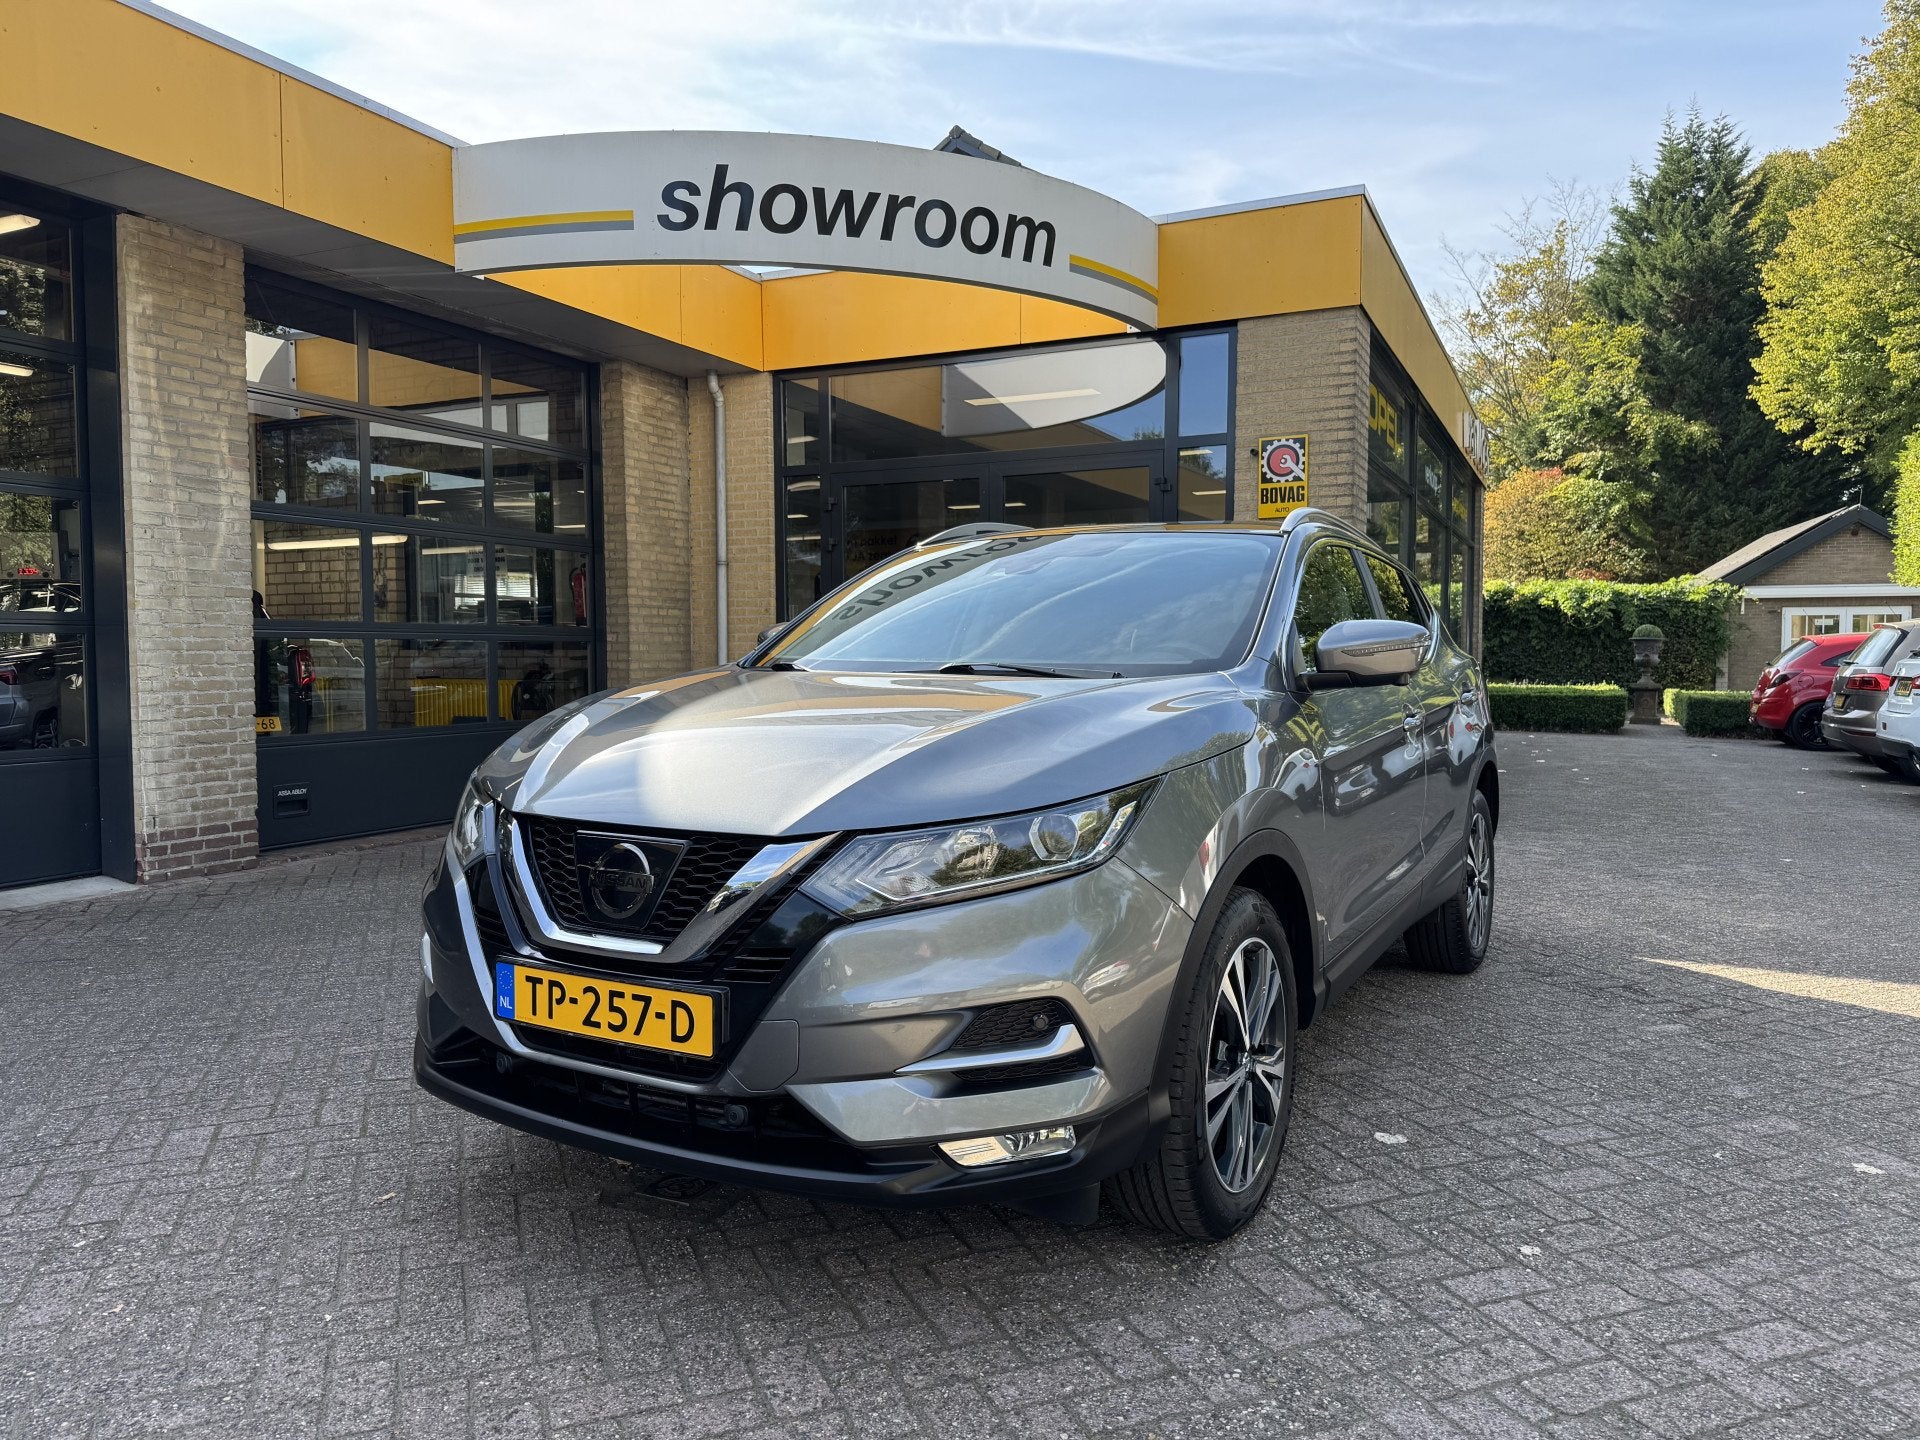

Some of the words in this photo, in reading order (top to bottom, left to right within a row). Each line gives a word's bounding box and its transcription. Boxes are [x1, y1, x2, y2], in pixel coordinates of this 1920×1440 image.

[656, 163, 1057, 268] showroom
[1368, 382, 1401, 453] OPEL
[1260, 485, 1305, 505] BOVAG
[277, 789, 292, 798] ASSA
[291, 787, 308, 796] ABLOY
[499, 995, 513, 1010] NL
[525, 975, 695, 1044] TP-257-D
